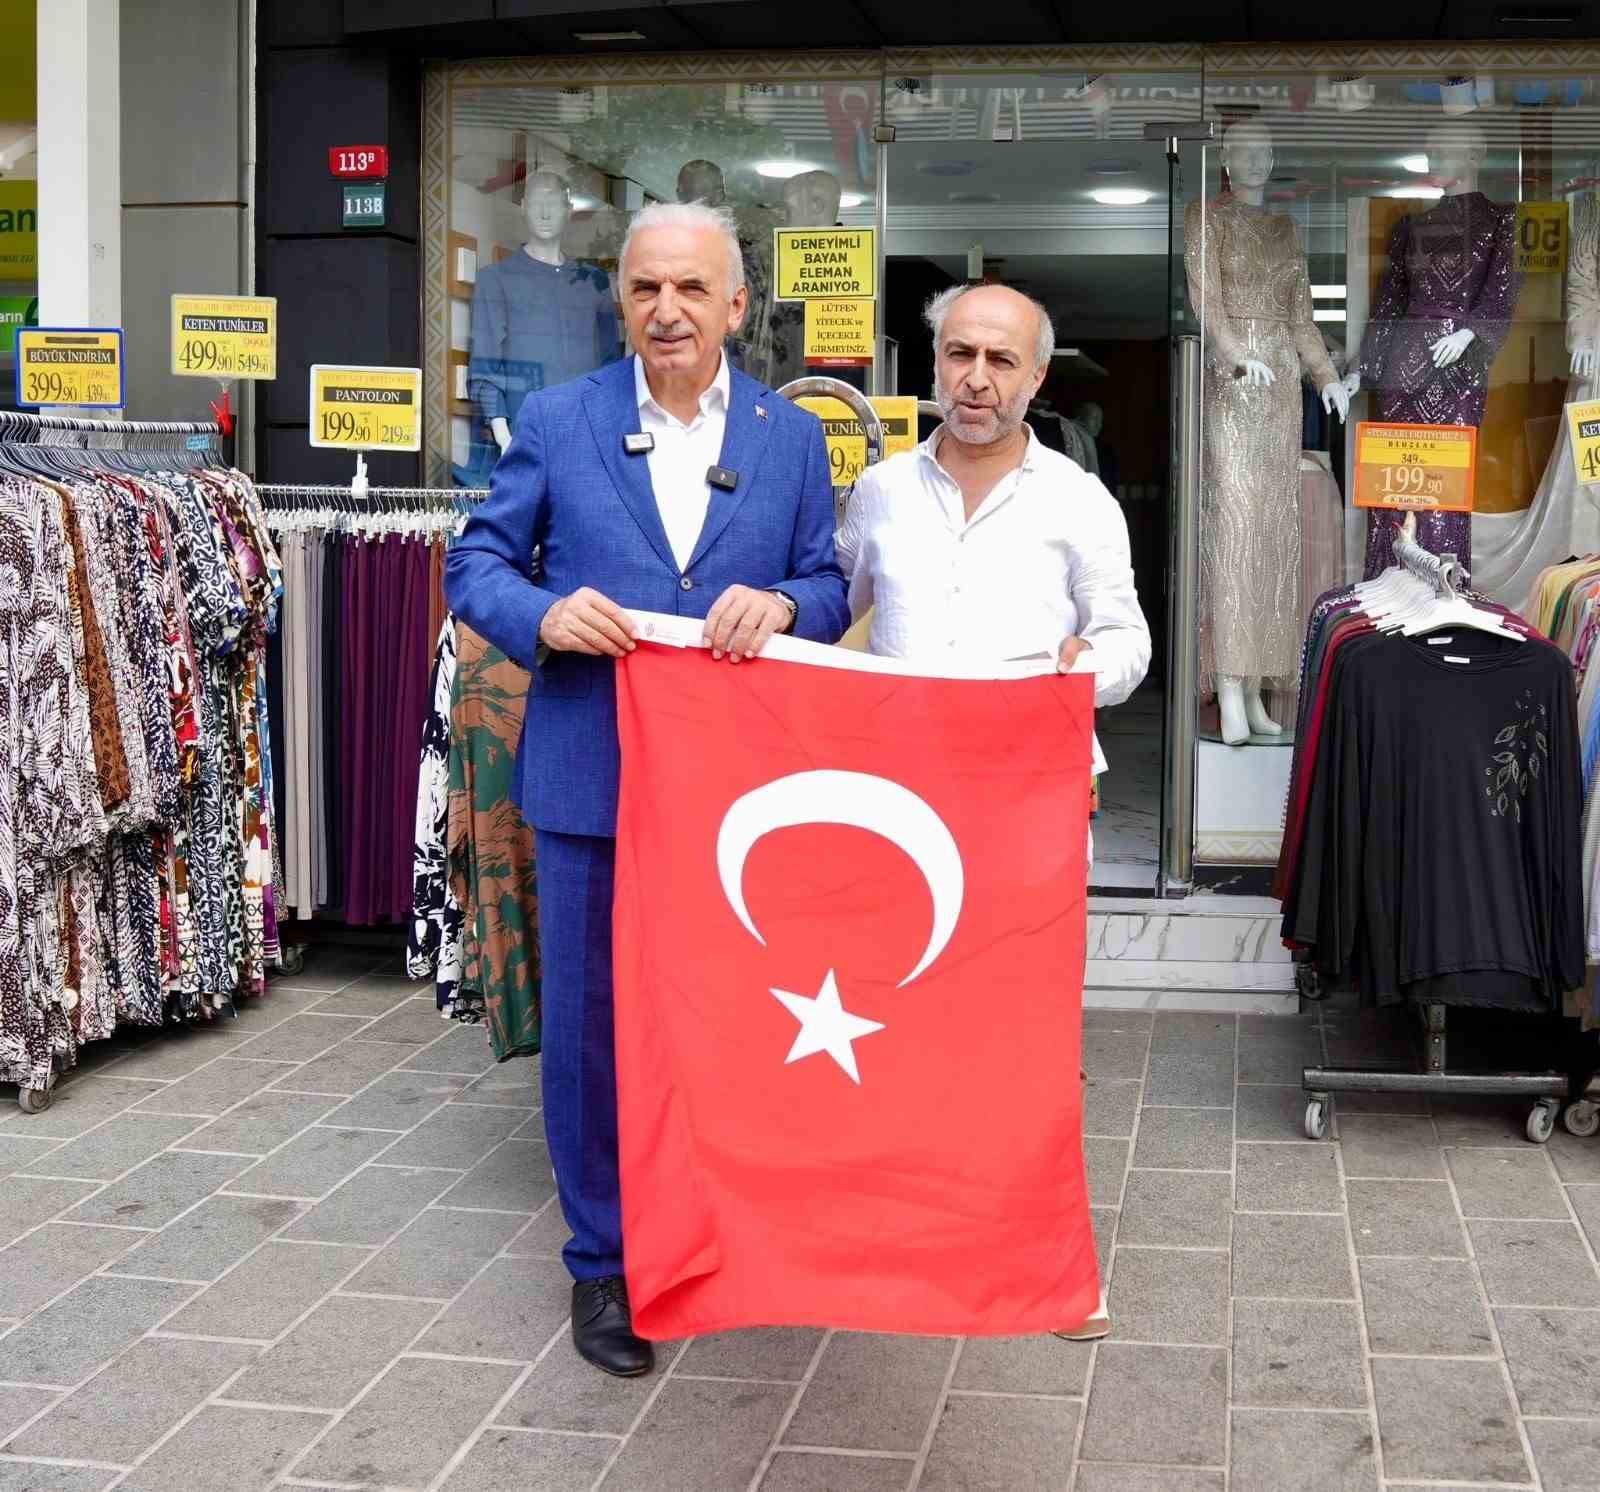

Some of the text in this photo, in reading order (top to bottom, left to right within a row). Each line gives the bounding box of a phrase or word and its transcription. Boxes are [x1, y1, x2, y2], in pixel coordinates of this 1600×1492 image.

[339, 152, 375, 171] 113B
[345, 197, 383, 214] 113B
[791, 235, 861, 250] DENEYİMLİ
[804, 252, 848, 264] BAYAN
[800, 266, 853, 278] ELEMAN
[792, 281, 860, 293] ARANIYOR
[821, 303, 858, 312] LÜTFEN
[184, 318, 265, 333] KETEN TUNİKLER
[816, 317, 853, 326] YİYECEK
[817, 331, 862, 341] İÇECEKLE
[30, 350, 111, 363] BÜYÜK İNDİRİM
[179, 340, 232, 371] 499.90
[27, 371, 78, 401] 399.90
[335, 389, 401, 402] PANTOLON
[321, 411, 371, 441] 199.90
[823, 419, 891, 435] TUNİKR
[1381, 466, 1442, 494] 199.90
